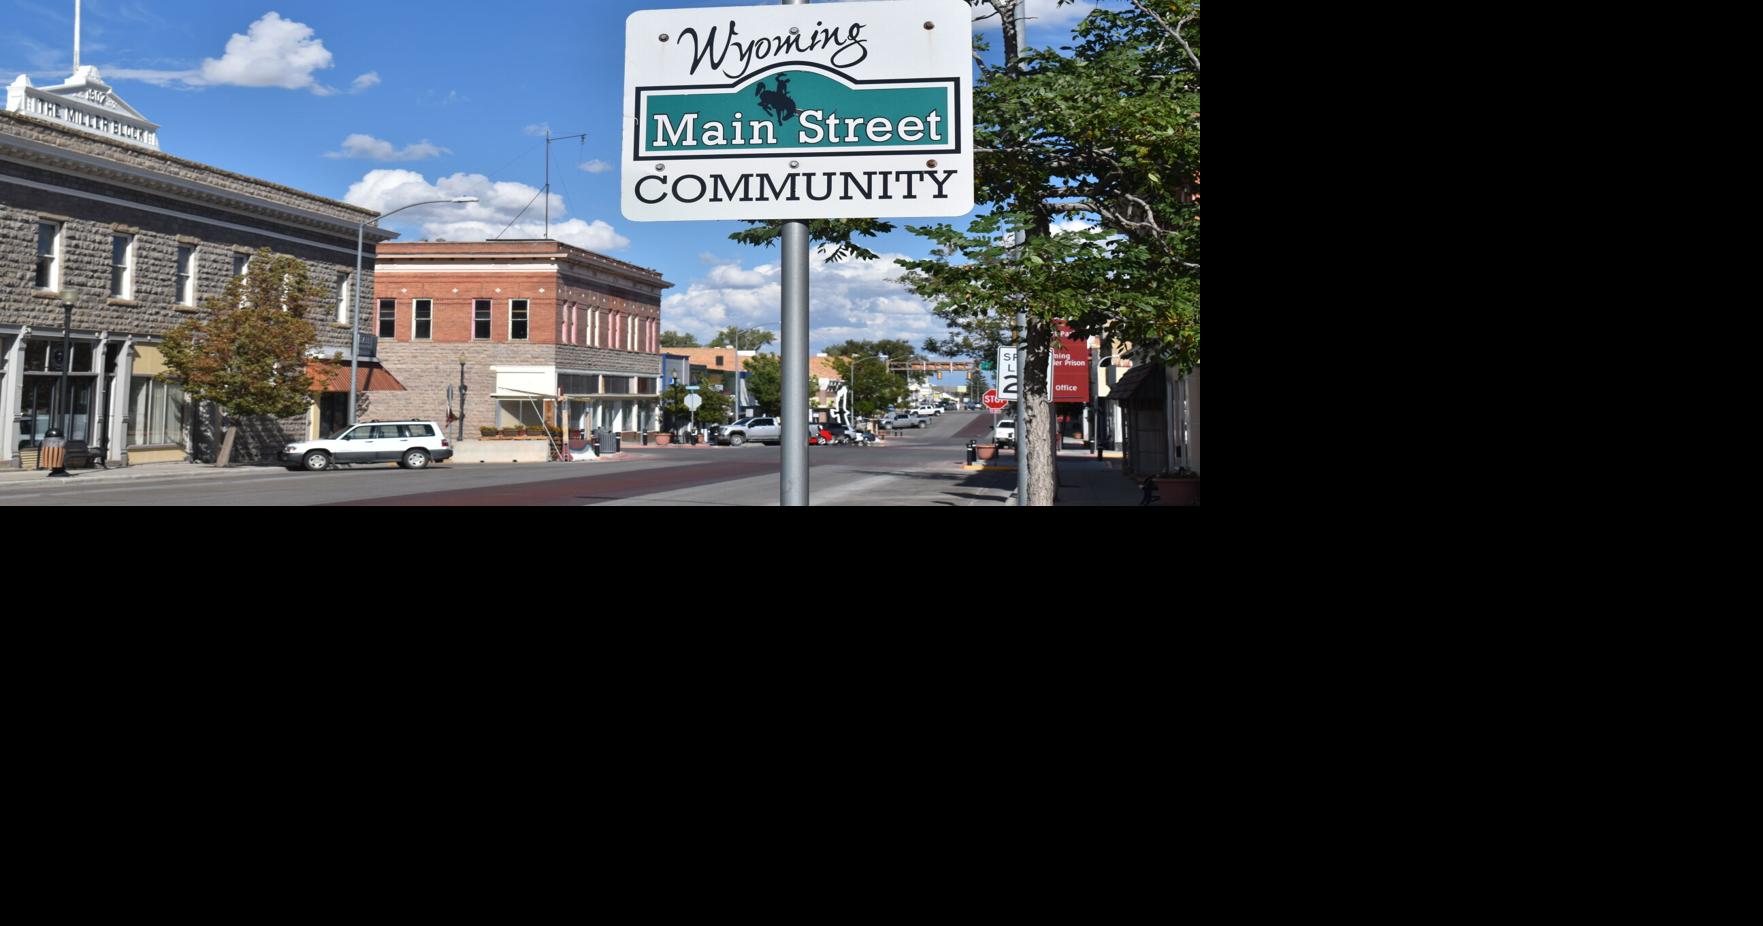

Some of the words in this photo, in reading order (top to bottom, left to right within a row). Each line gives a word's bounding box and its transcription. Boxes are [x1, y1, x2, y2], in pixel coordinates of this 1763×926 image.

[677, 20, 867, 79] Wyoming
[39, 98, 60, 118] THE
[65, 106, 108, 132] MILLER
[111, 120, 143, 142] BLOCK
[652, 112, 777, 147] Main
[799, 108, 941, 145] Street
[634, 170, 958, 204] COMMUNITY
[984, 395, 1004, 403] STO
